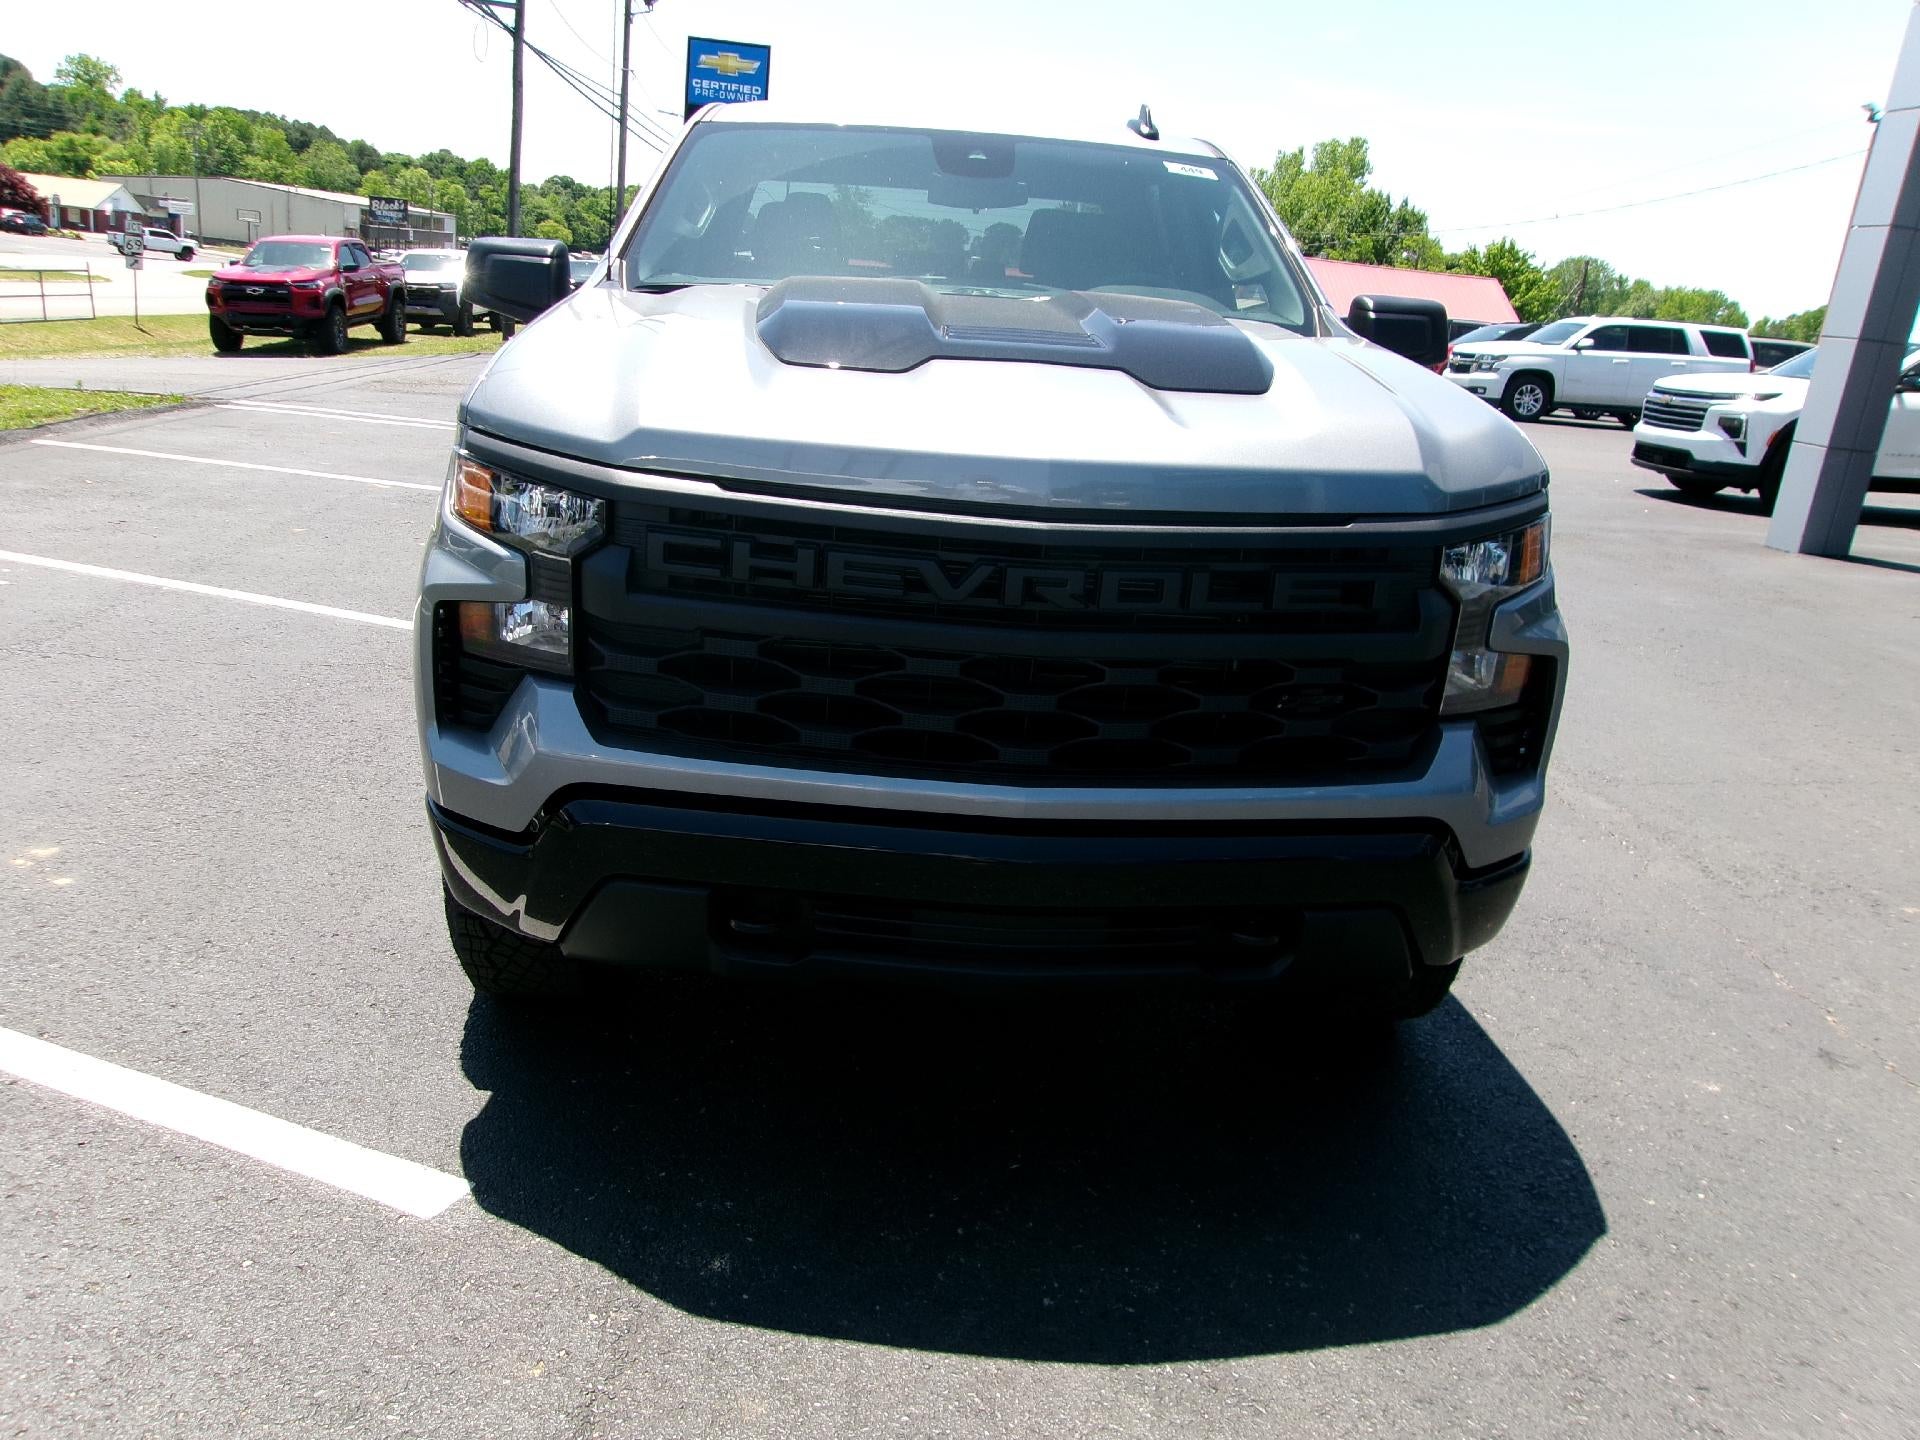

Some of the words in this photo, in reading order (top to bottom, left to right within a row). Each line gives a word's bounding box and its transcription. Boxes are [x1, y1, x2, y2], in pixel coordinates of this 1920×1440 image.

[692, 79, 761, 95] CERTIFIED
[695, 88, 758, 102] PRE-OWNED
[646, 530, 1408, 612] CHEVROLET
